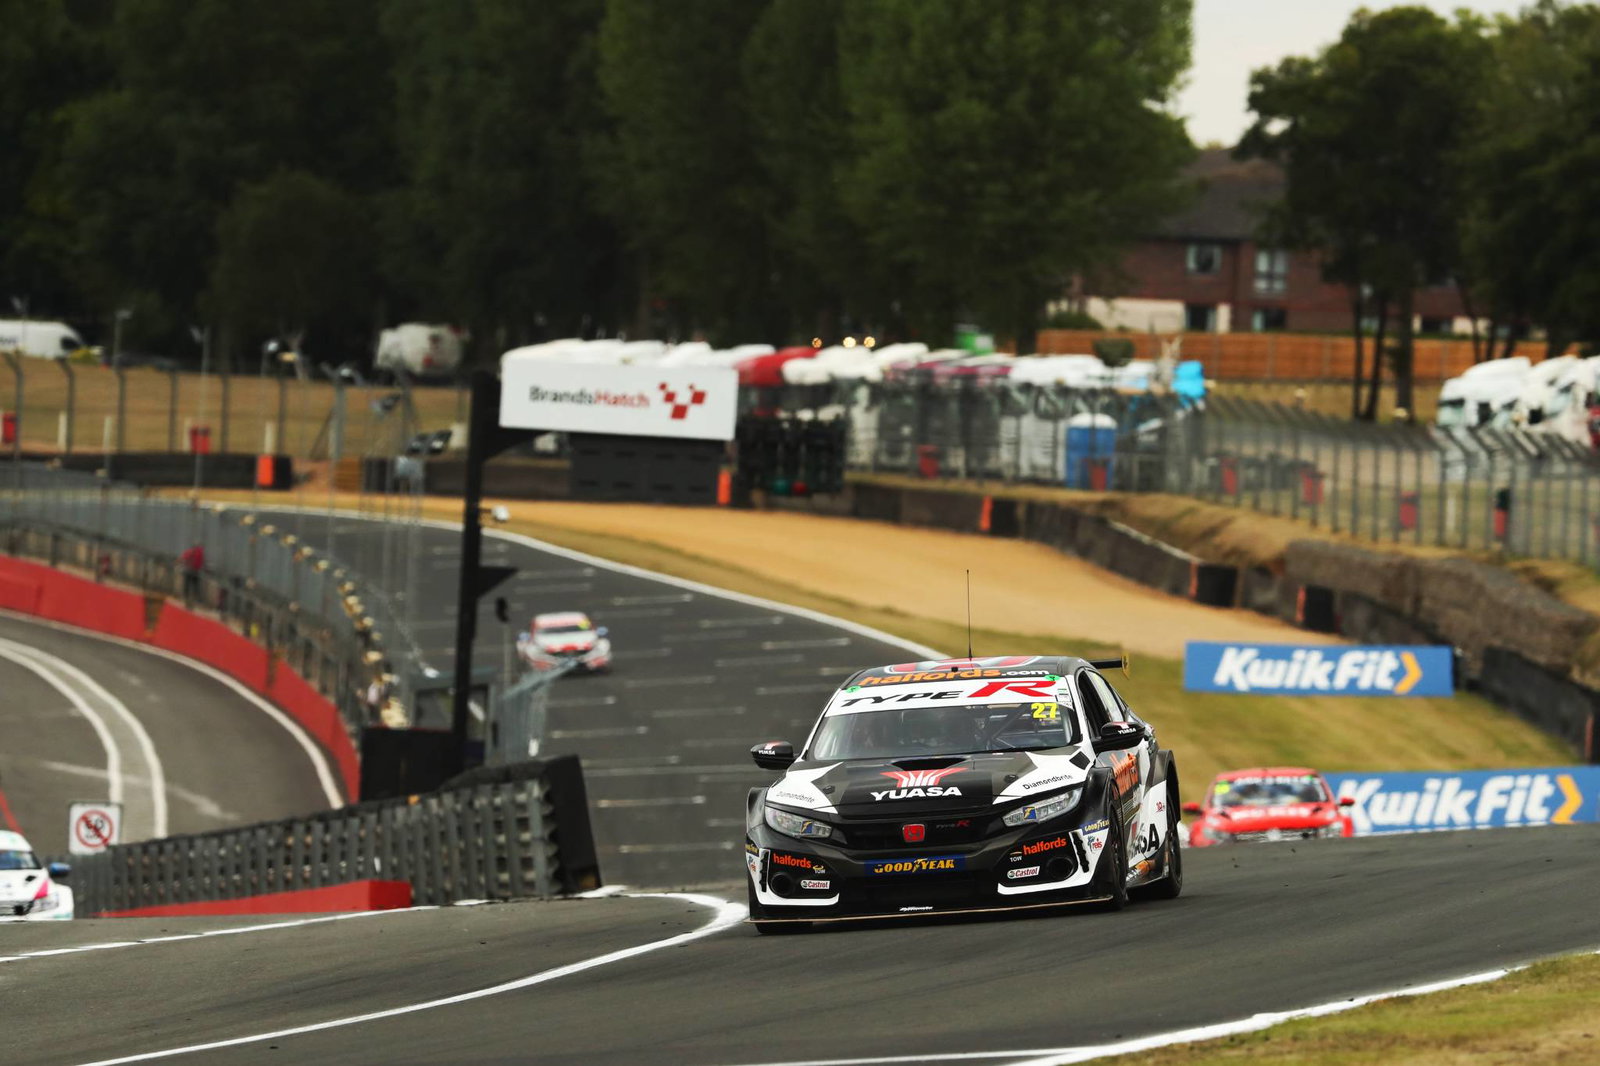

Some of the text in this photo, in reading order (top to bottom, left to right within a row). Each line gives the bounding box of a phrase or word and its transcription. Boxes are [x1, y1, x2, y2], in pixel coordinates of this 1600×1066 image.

[858, 668, 1050, 686] halfords.com
[841, 690, 964, 708] TYPE
[966, 680, 1057, 698] R
[1030, 702, 1059, 720] 27
[1022, 773, 1074, 790] Diamondbrite
[870, 786, 963, 802] YUASA
[1022, 837, 1067, 856] halfords
[773, 853, 812, 869] halfords
[1010, 855, 1023, 863] TOW
[1015, 867, 1038, 878] Castrol
[807, 880, 829, 889] Castrol
